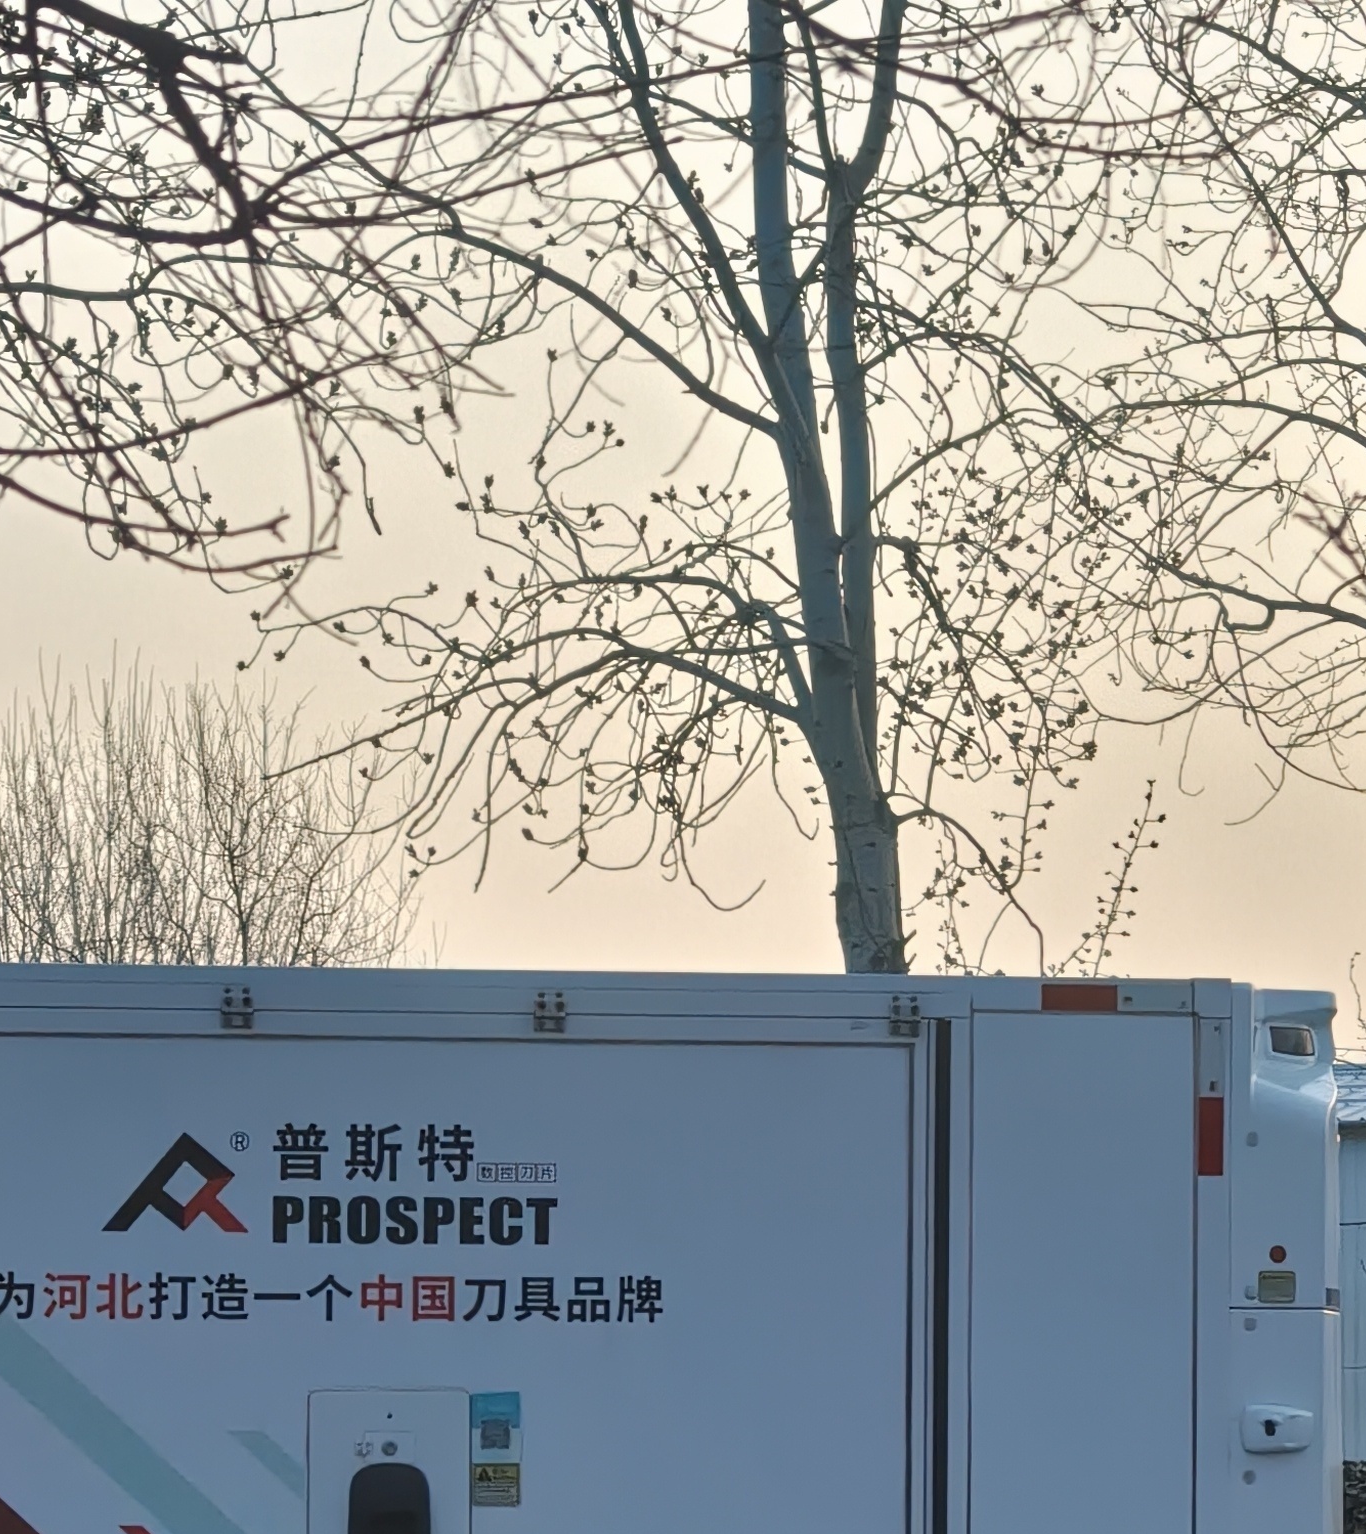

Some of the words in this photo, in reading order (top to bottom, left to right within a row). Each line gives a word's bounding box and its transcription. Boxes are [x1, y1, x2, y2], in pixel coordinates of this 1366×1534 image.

[273, 1123, 474, 1182] 普斯特
[480, 1165, 554, 1181] 数控刀片
[272, 1195, 559, 1246] PROSPECT
